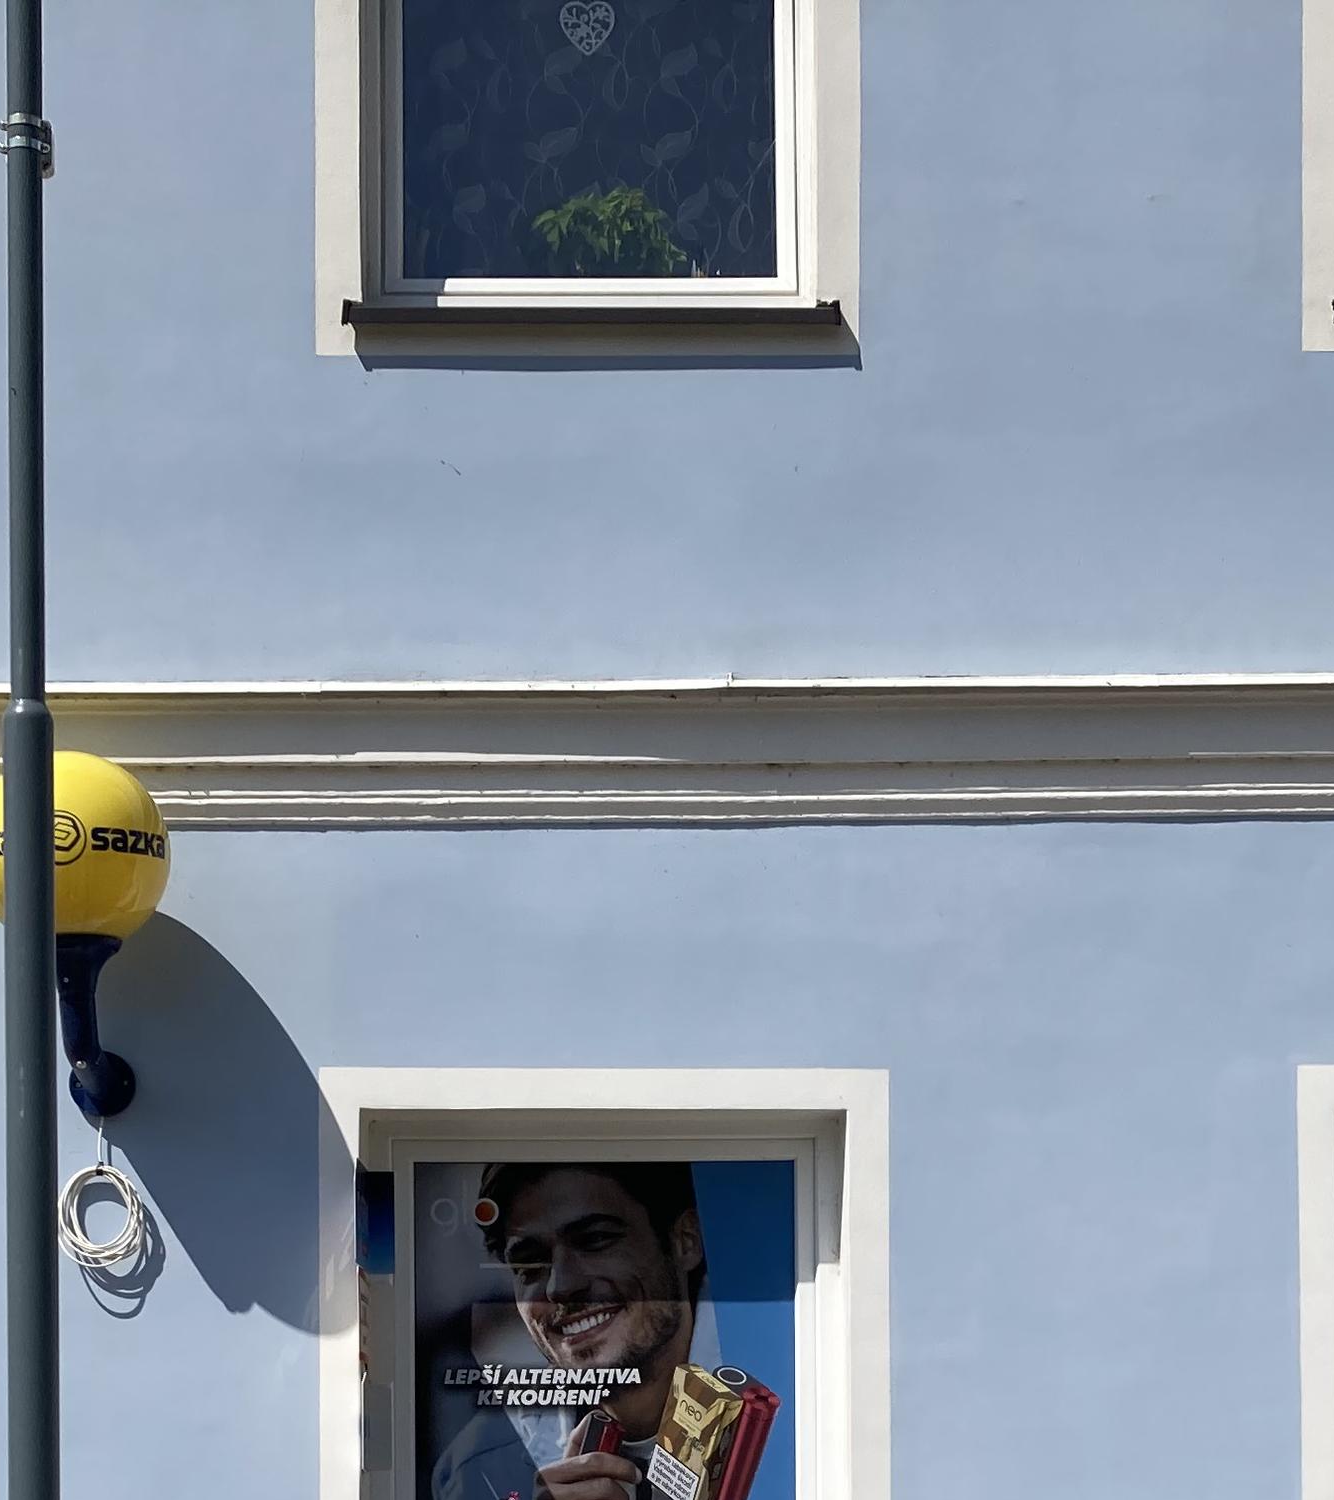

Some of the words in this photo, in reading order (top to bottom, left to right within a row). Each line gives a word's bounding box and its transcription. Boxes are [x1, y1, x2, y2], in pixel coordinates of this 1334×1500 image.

[444, 1365, 504, 1384] LEPŠÍ
[503, 1368, 641, 1384] ALTERNATIVA
[477, 1390, 503, 1405] KE
[680, 1399, 702, 1422] neo
